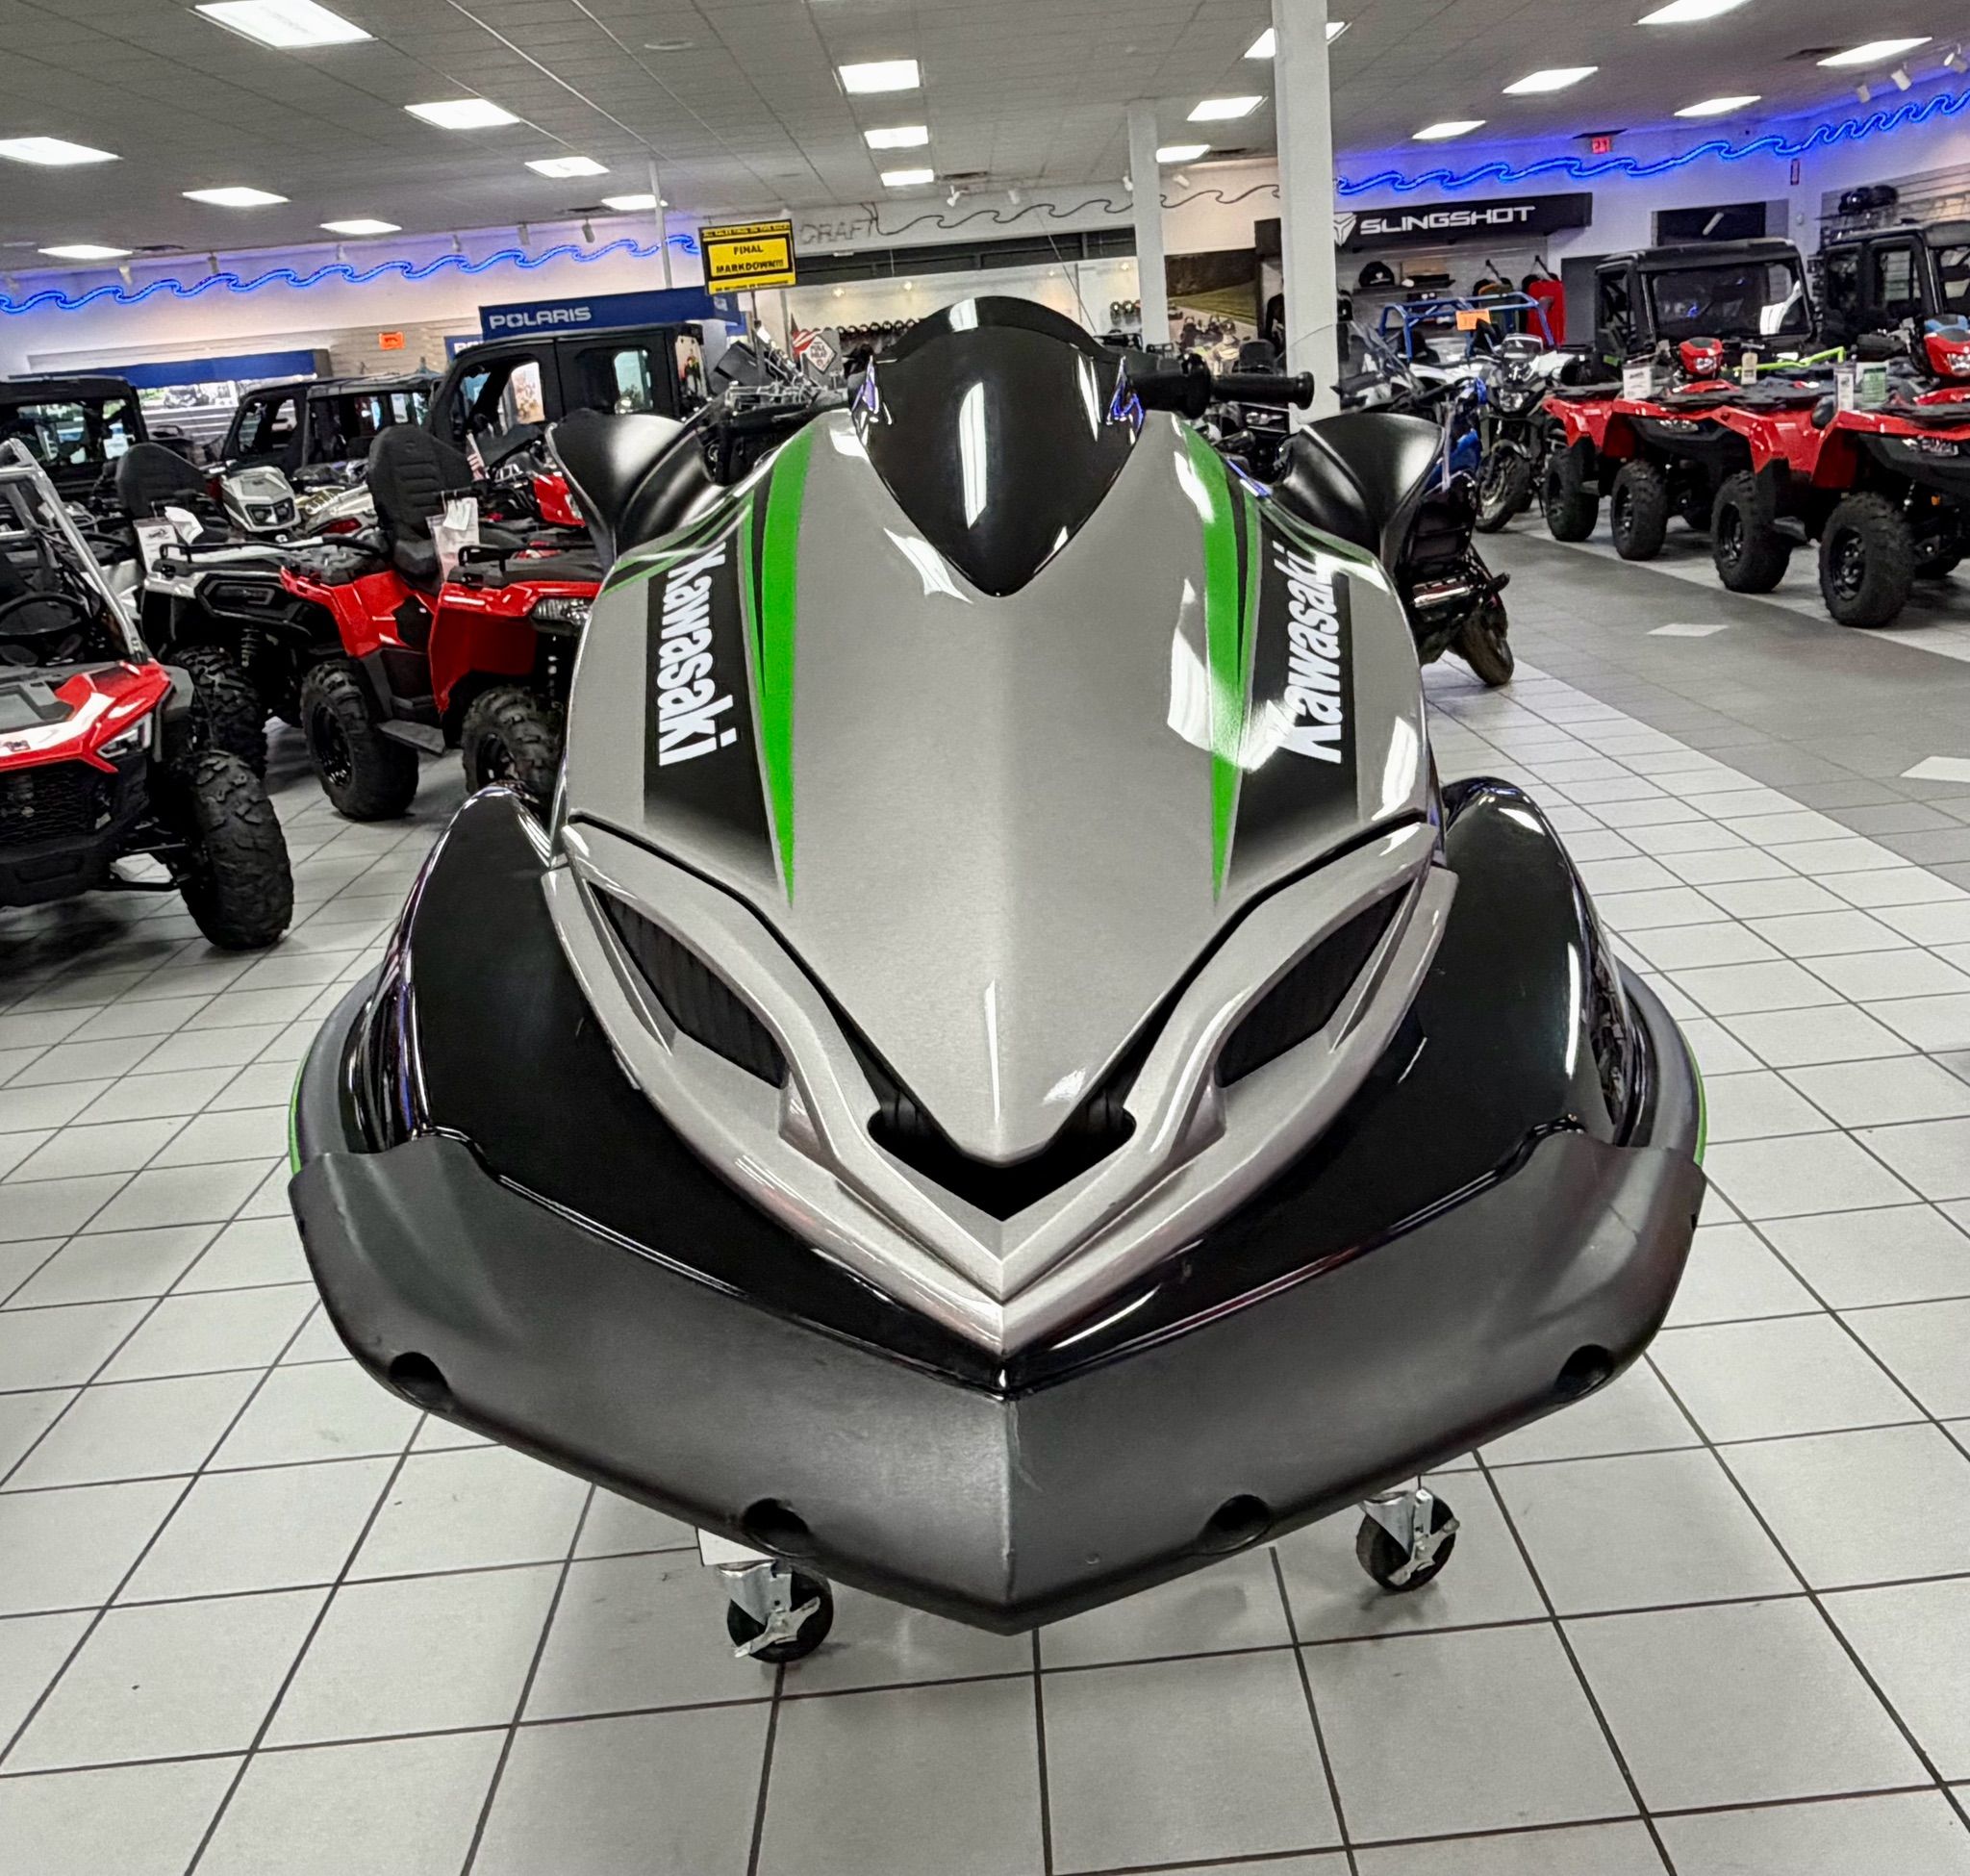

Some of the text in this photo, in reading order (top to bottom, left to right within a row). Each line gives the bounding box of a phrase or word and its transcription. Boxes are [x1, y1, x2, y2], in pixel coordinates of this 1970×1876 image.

[1360, 206, 1535, 235] SLINGSHOT
[733, 244, 764, 256] FINAL
[489, 306, 593, 330] POLARIS
[657, 541, 738, 767] Kawasaki
[1272, 540, 1344, 764] Kawasaki
